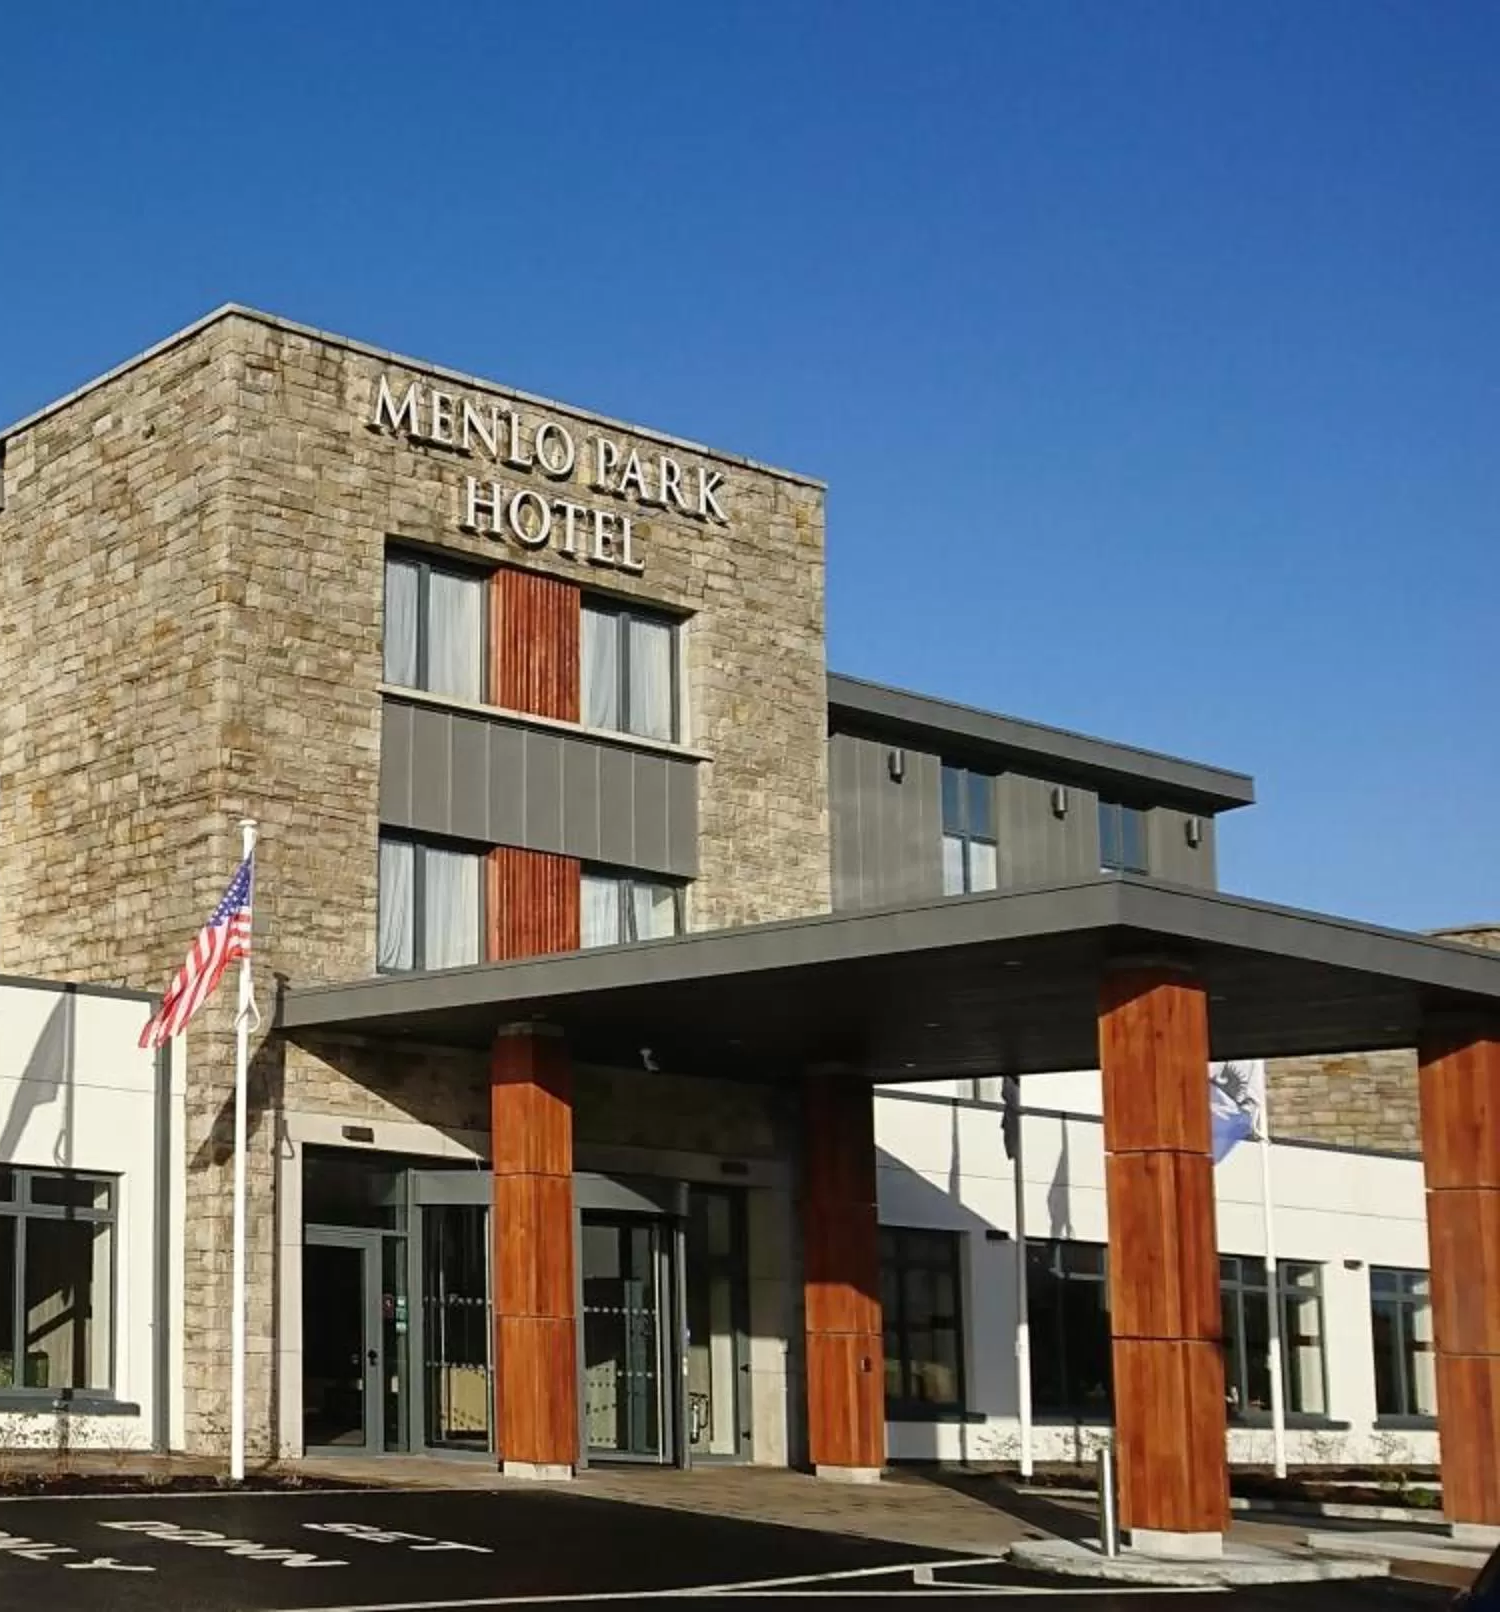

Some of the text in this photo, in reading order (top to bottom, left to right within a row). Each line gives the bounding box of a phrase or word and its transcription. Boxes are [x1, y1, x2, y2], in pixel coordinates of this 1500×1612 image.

[373, 374, 730, 523] MENLO PARK
[464, 475, 646, 571] HOTEL
[97, 1521, 351, 1567] DOWN
[302, 1522, 495, 1554] SET
